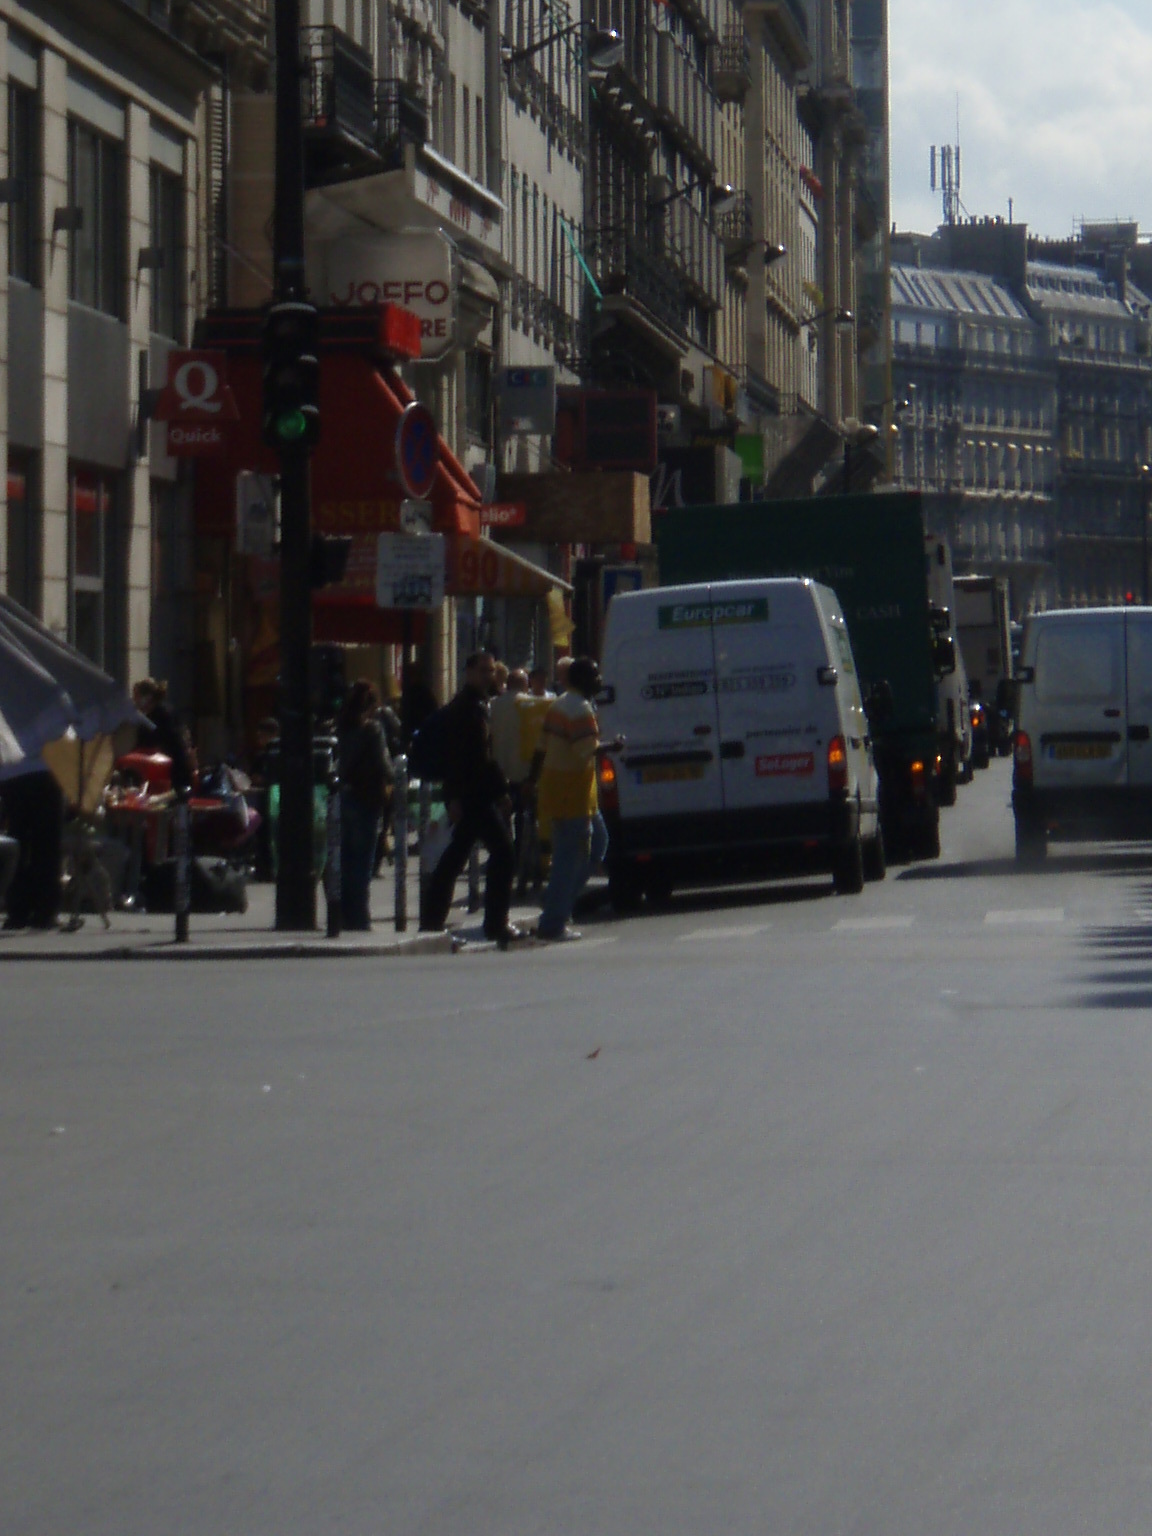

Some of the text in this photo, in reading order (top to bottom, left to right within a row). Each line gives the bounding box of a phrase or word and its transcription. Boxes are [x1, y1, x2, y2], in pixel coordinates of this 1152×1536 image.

[330, 280, 449, 306] JOFFO
[175, 360, 223, 413] Q
[171, 427, 222, 445] Quick
[672, 602, 756, 623] Europcar
